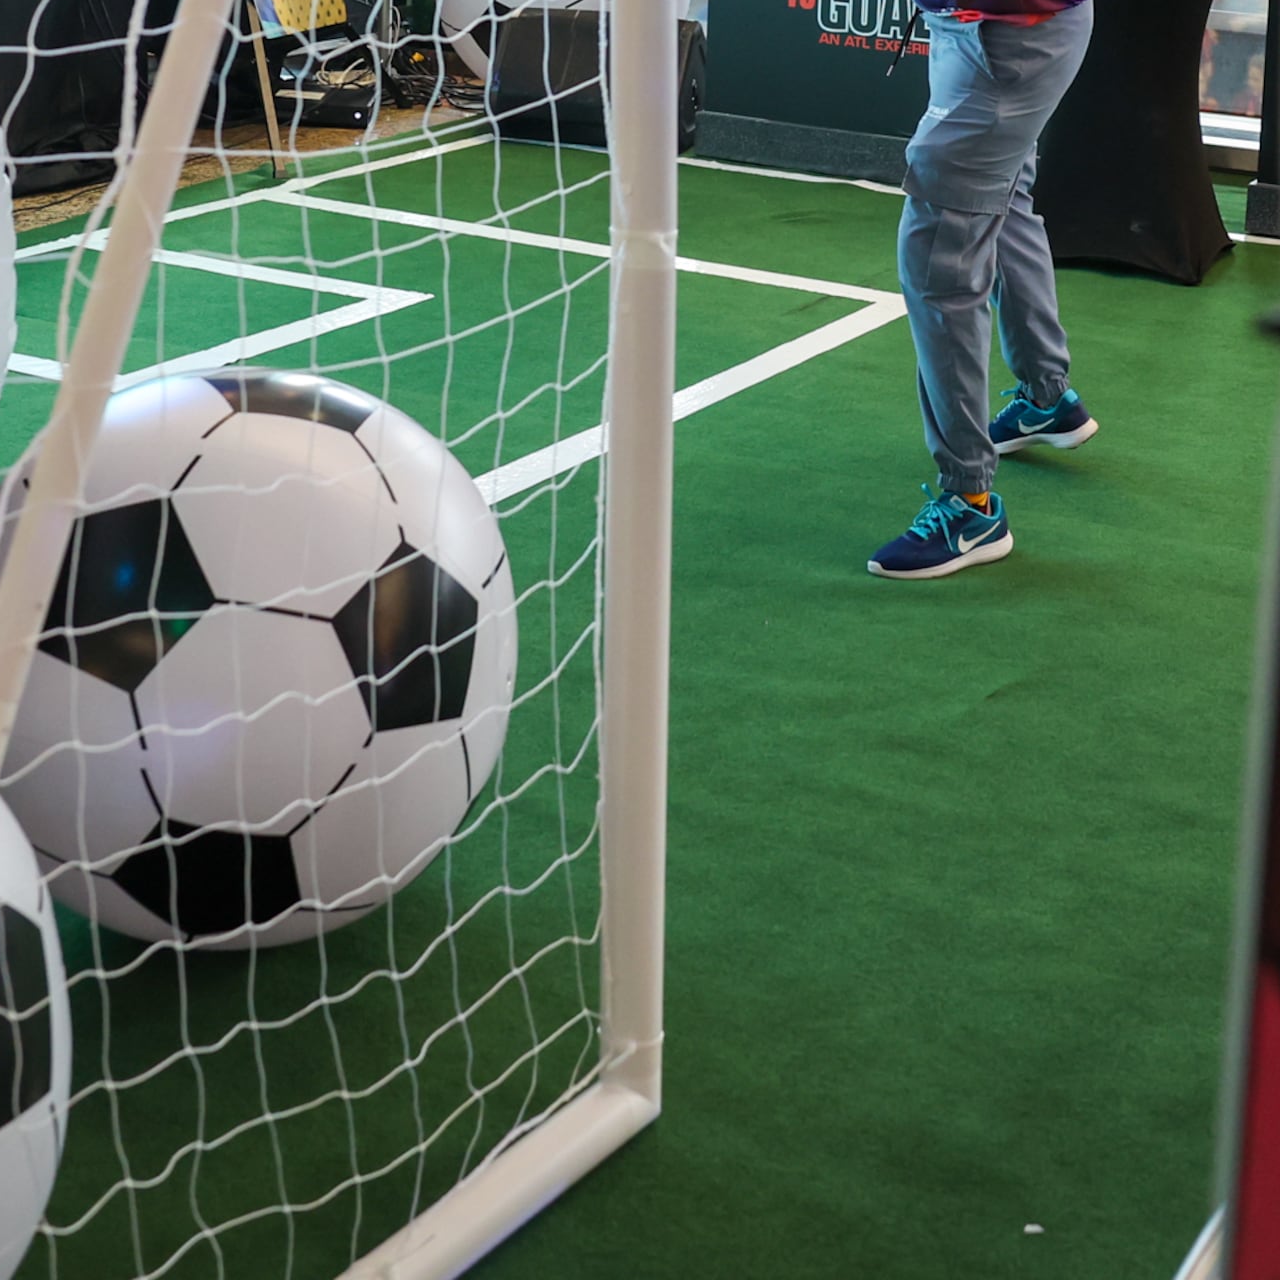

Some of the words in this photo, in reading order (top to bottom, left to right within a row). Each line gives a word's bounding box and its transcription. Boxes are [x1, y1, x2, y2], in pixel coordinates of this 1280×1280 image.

[818, 32, 840, 45] AN
[844, 35, 870, 49] ATL
[875, 39, 929, 56] EXPERI
